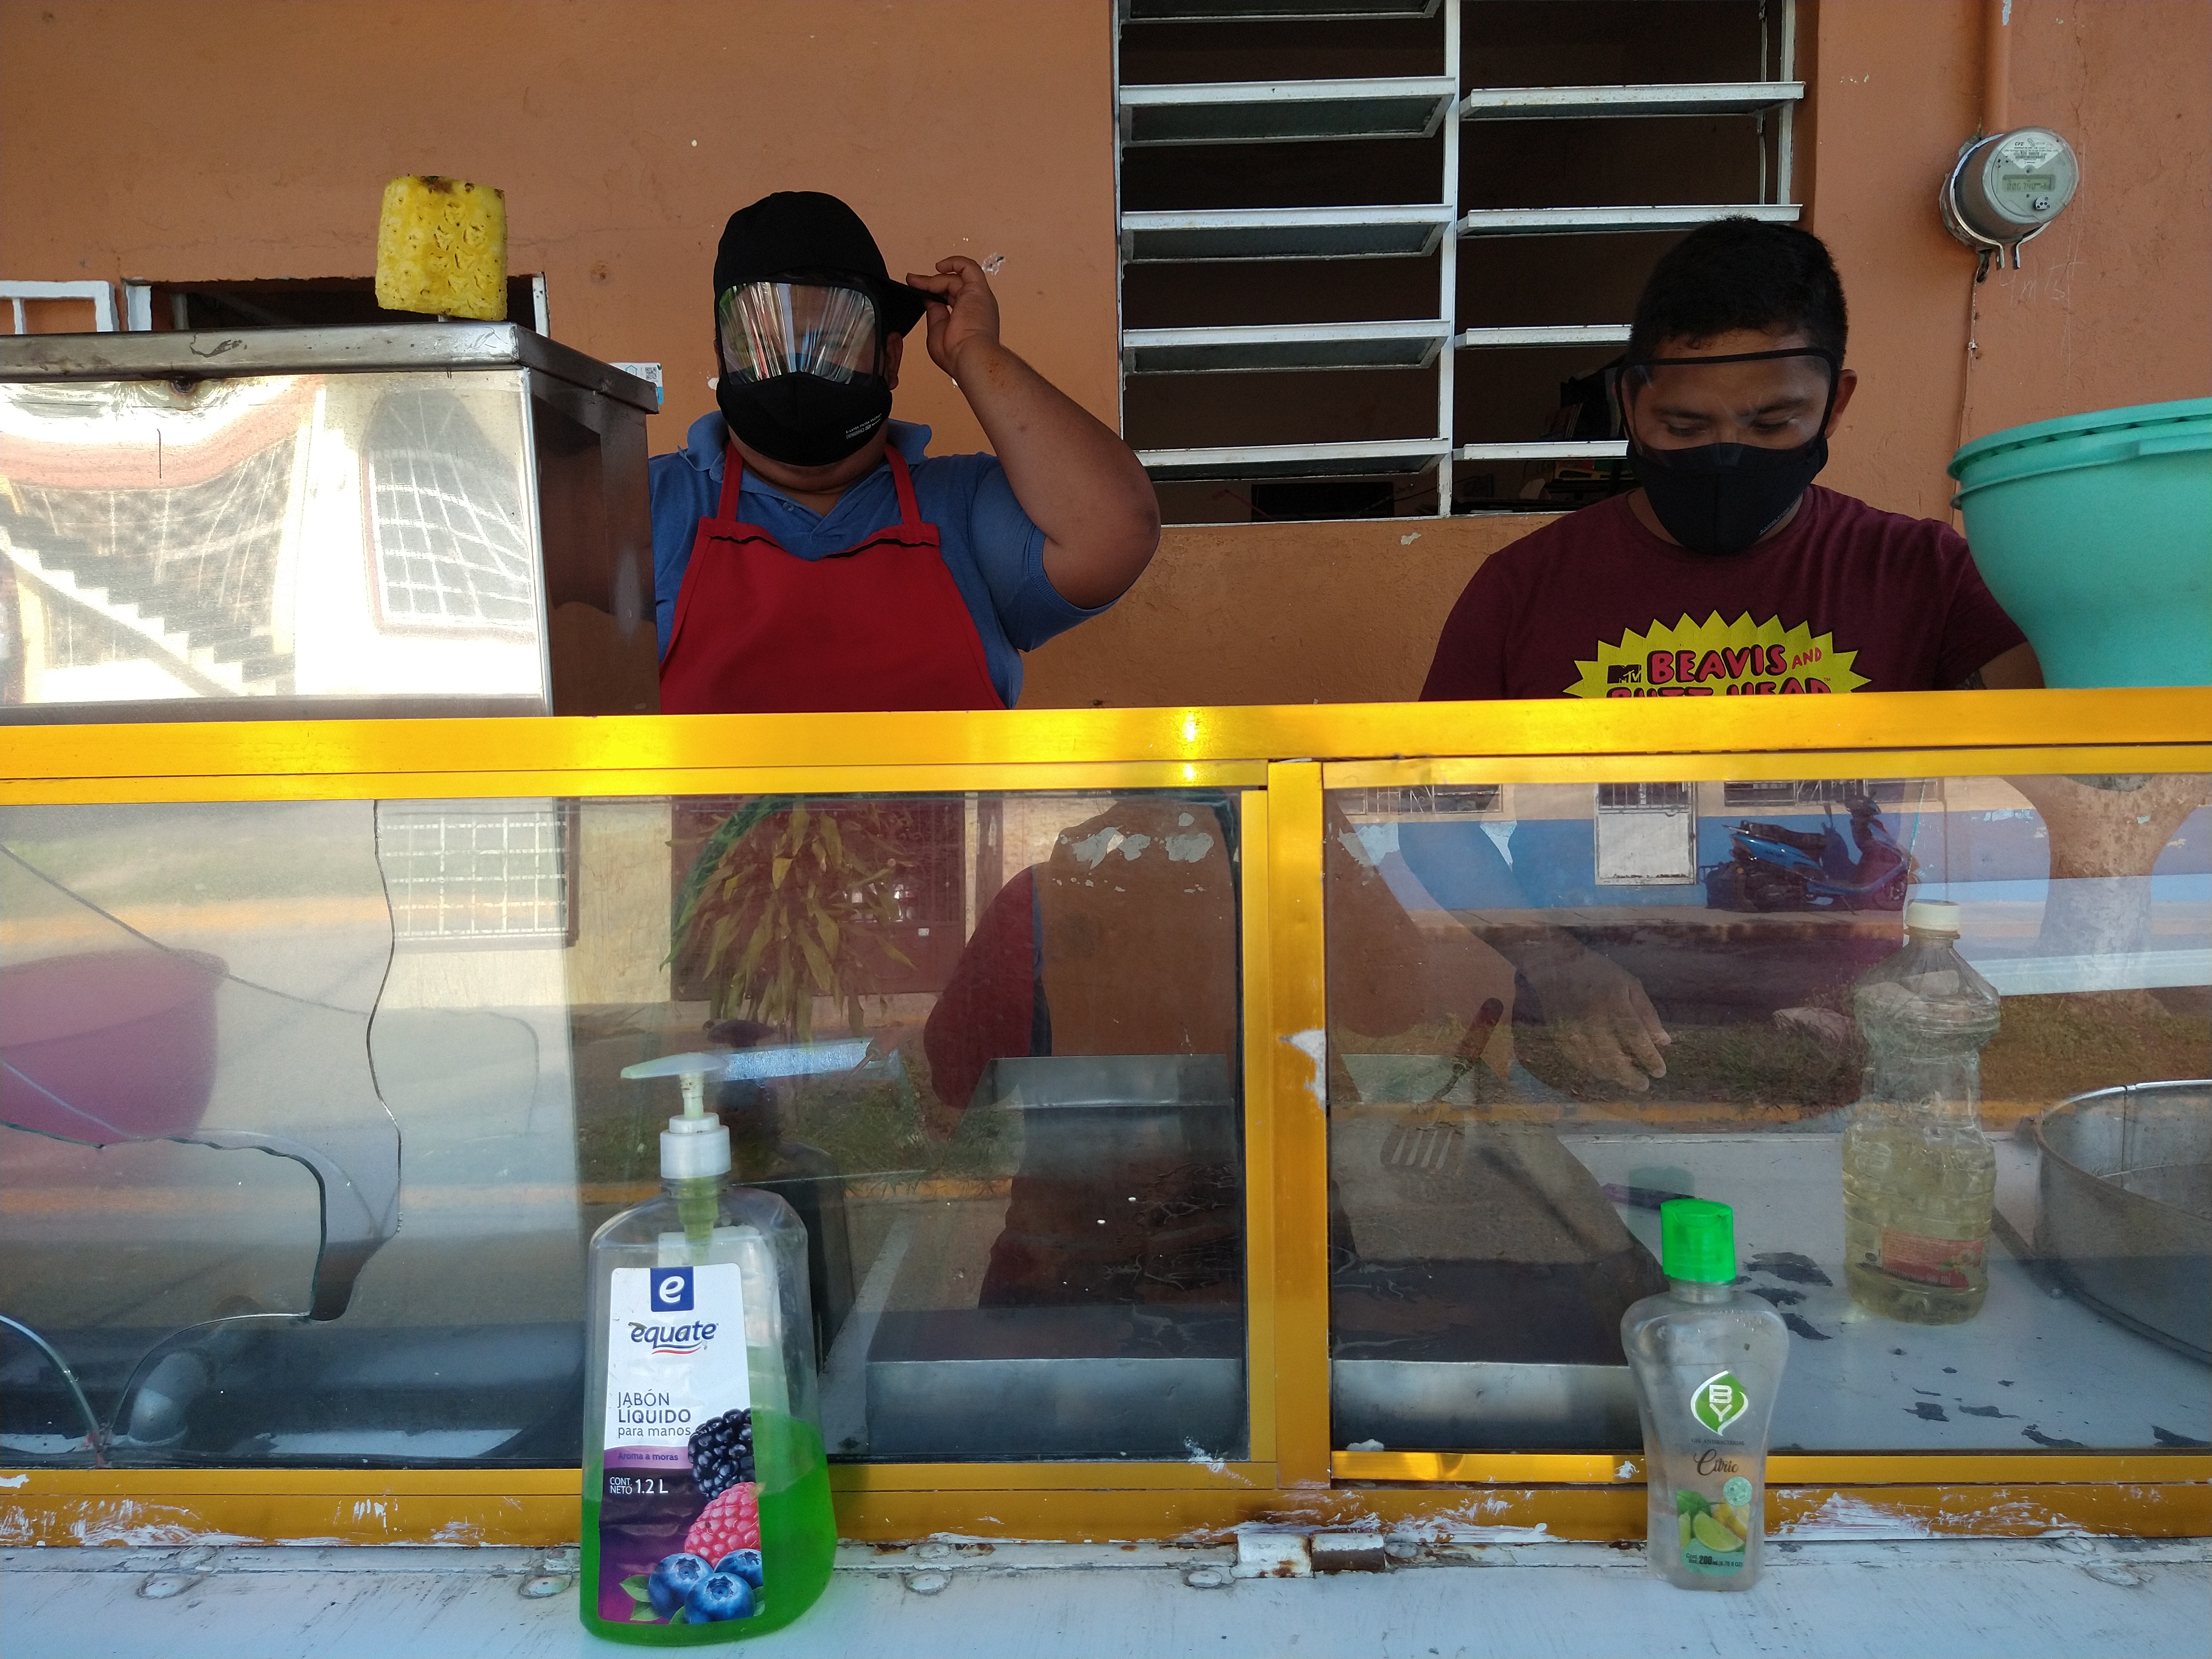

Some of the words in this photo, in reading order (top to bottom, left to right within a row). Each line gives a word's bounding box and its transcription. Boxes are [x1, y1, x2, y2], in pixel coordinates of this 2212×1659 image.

[1607, 664, 1641, 684] MTV
[1647, 644, 1788, 685] BEAVIS
[1791, 646, 1822, 670] AND
[659, 1275, 685, 1303] e
[631, 1320, 717, 1350] equate
[617, 1389, 670, 1408] JABÓN
[618, 1405, 691, 1424] LÍQUIDO
[618, 1427, 644, 1439] para
[648, 1427, 691, 1436] manos
[1693, 1448, 1739, 1476] Citric
[610, 1477, 633, 1486] CONT.
[610, 1485, 633, 1494] NETO
[635, 1479, 654, 1494] 1.2
[659, 1479, 669, 1494] L
[1699, 1555, 1713, 1565] 200
